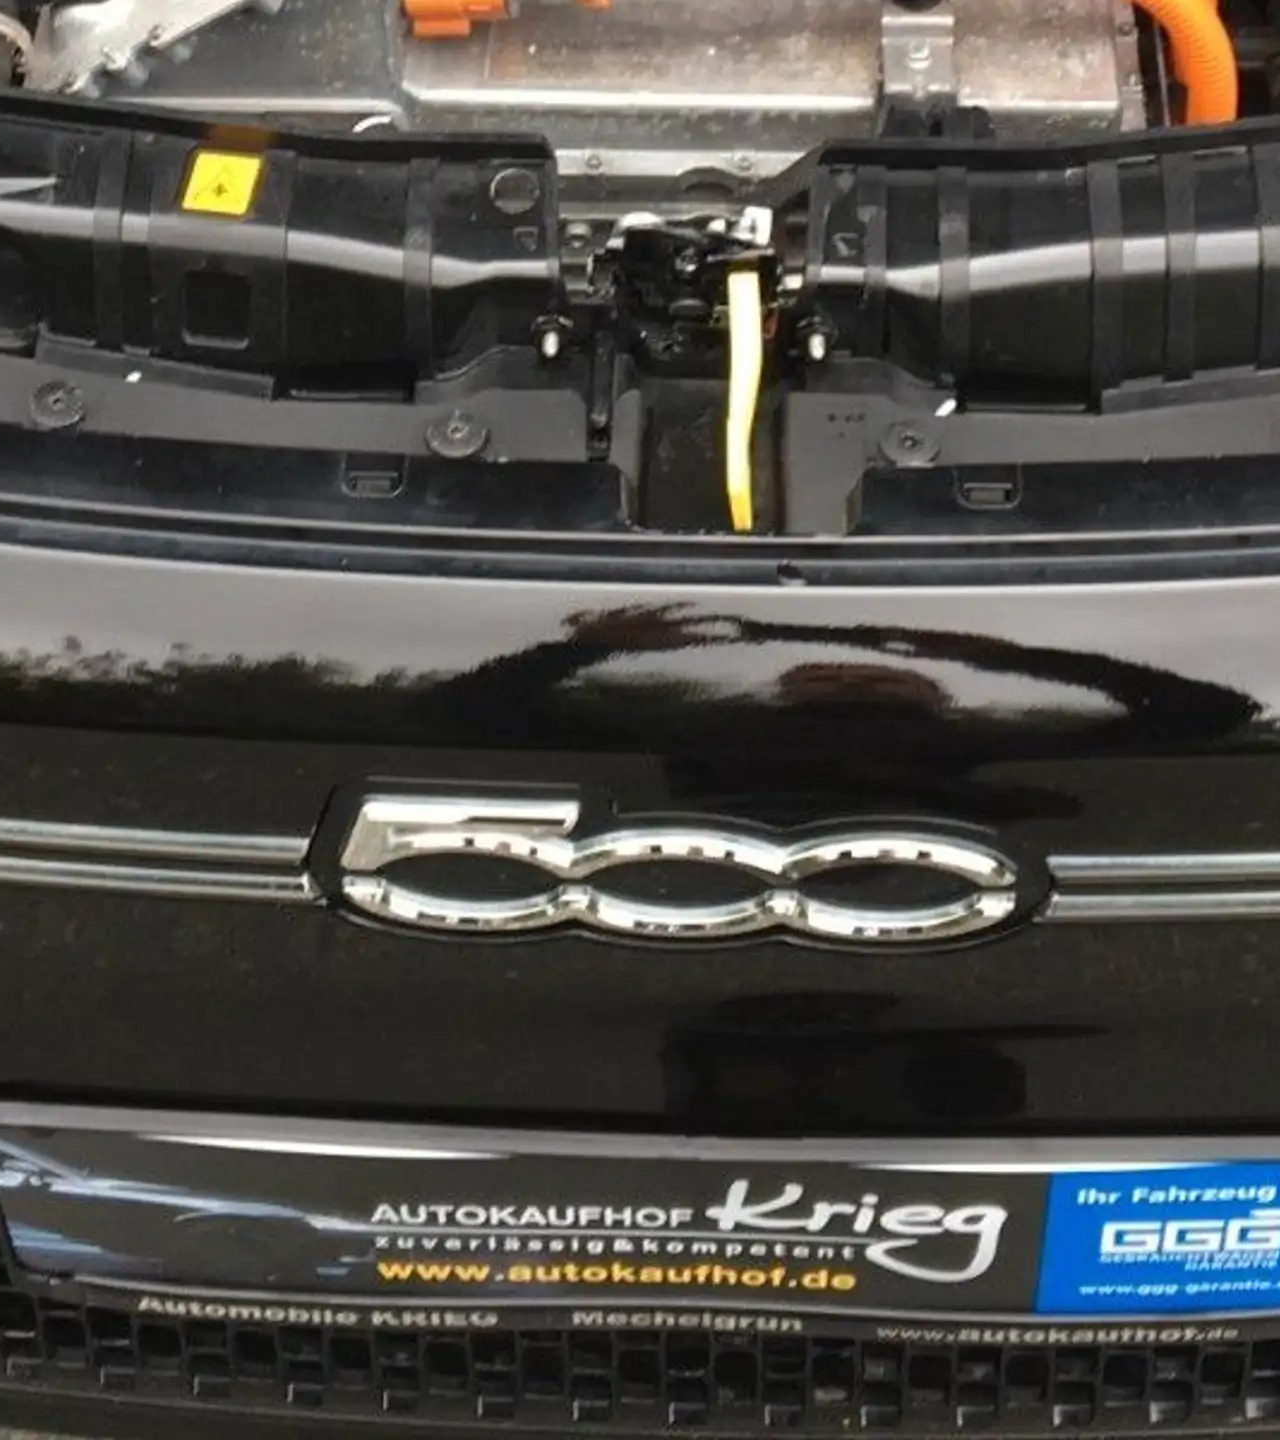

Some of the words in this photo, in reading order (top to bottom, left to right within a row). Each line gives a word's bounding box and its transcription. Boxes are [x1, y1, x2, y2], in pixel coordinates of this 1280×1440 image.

[340, 799, 1017, 940] 500
[1076, 1185, 1122, 1206] Ihr
[1131, 1180, 1279, 1203] Fahrzeug
[370, 1202, 696, 1230] AUTOKAUFHOF
[704, 1179, 1009, 1283] Krieg
[376, 1261, 858, 1291] www.autokaufhof.de
[138, 1295, 360, 1326] Automobile
[876, 1324, 1240, 1344] www.autokaufhof.de
